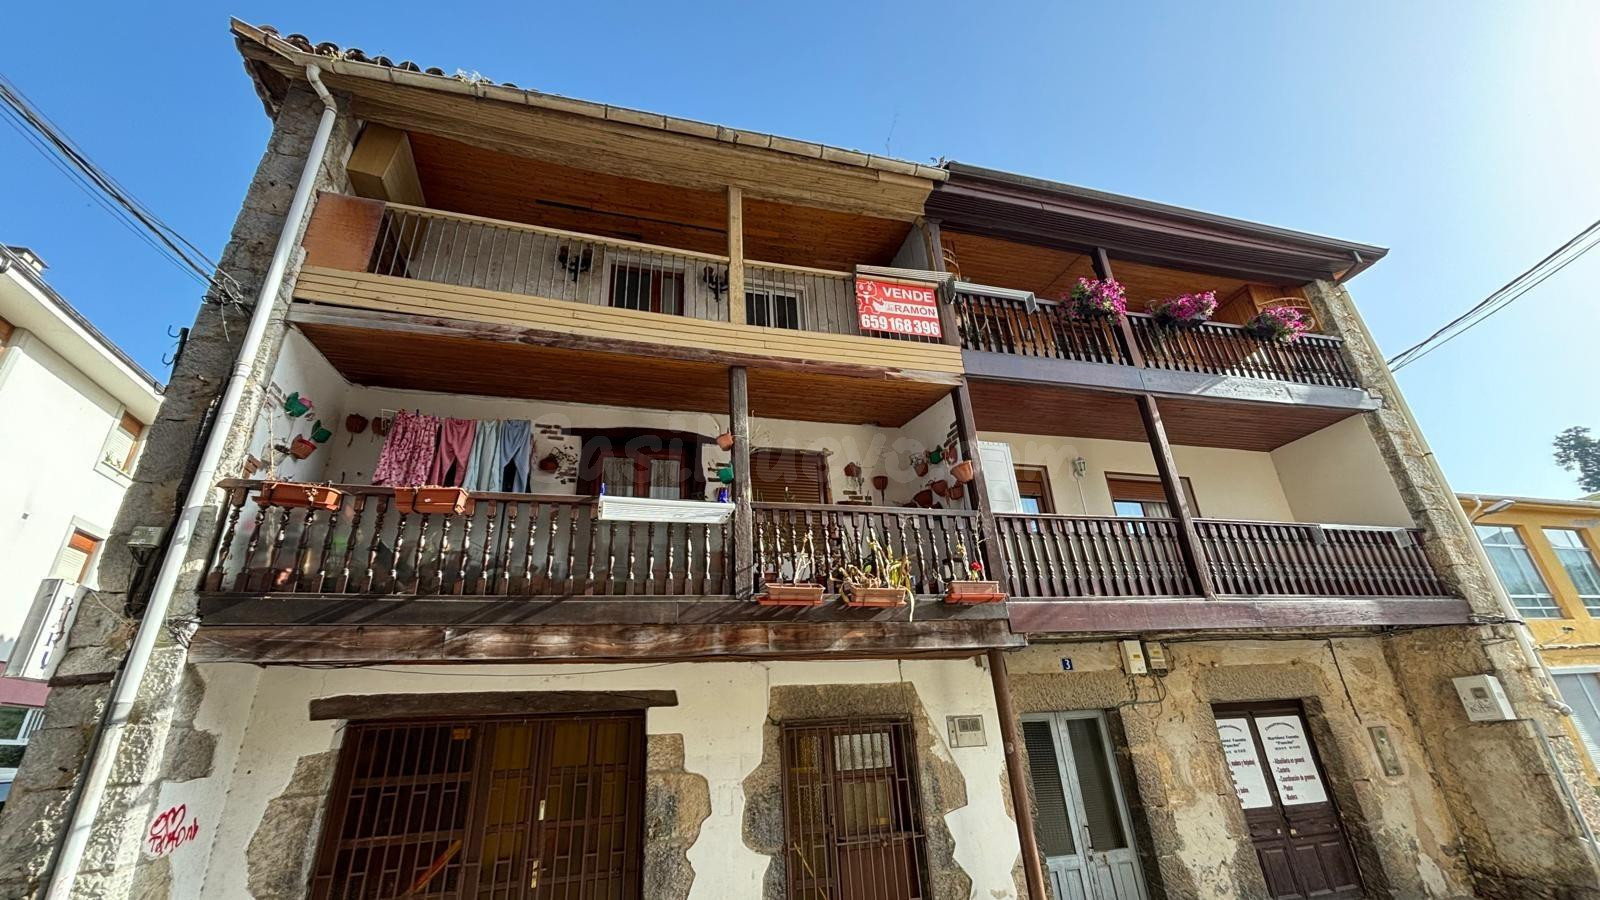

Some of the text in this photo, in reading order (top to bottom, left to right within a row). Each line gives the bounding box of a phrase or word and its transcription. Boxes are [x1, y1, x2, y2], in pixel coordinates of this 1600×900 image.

[882, 286, 933, 303] VENDE
[861, 314, 939, 336] 659 168 396
[1064, 659, 1071, 670] 3
